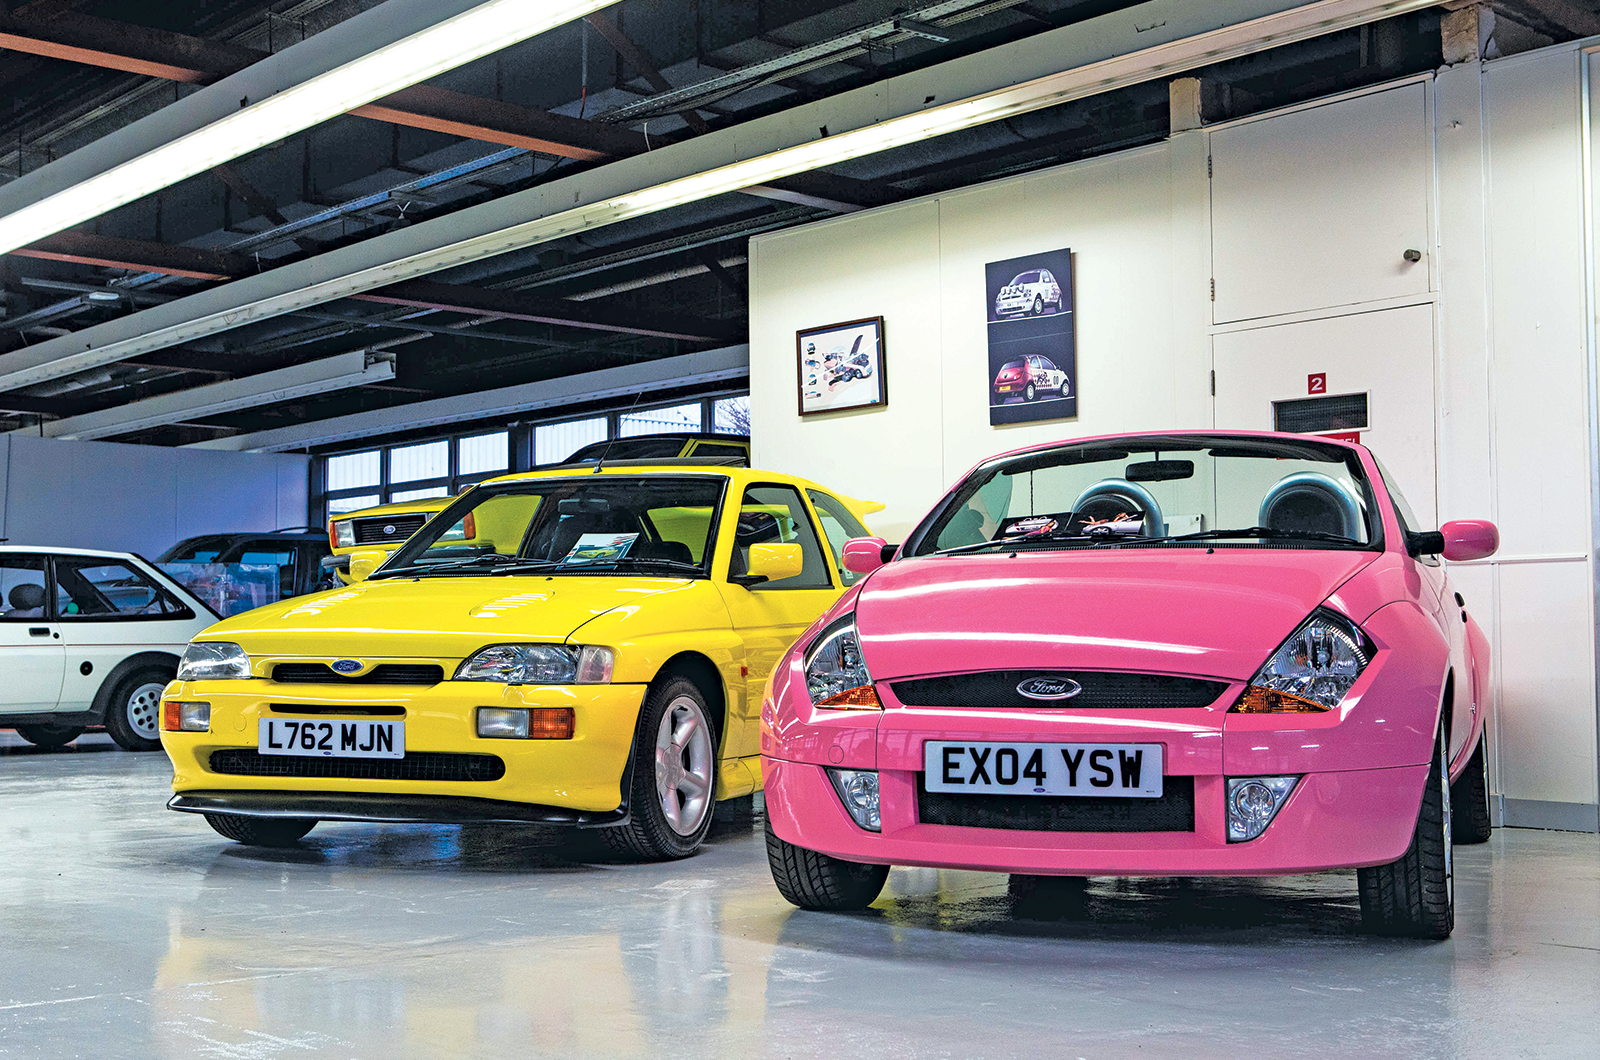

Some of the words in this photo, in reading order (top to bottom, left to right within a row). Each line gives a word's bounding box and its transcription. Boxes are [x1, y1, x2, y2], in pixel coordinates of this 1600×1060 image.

[1311, 377, 1323, 391] 2
[1030, 680, 1066, 693] Ford
[268, 721, 333, 751] L762
[341, 723, 393, 752] MJN
[942, 747, 1047, 787] EX04
[1060, 749, 1143, 789] YSW
